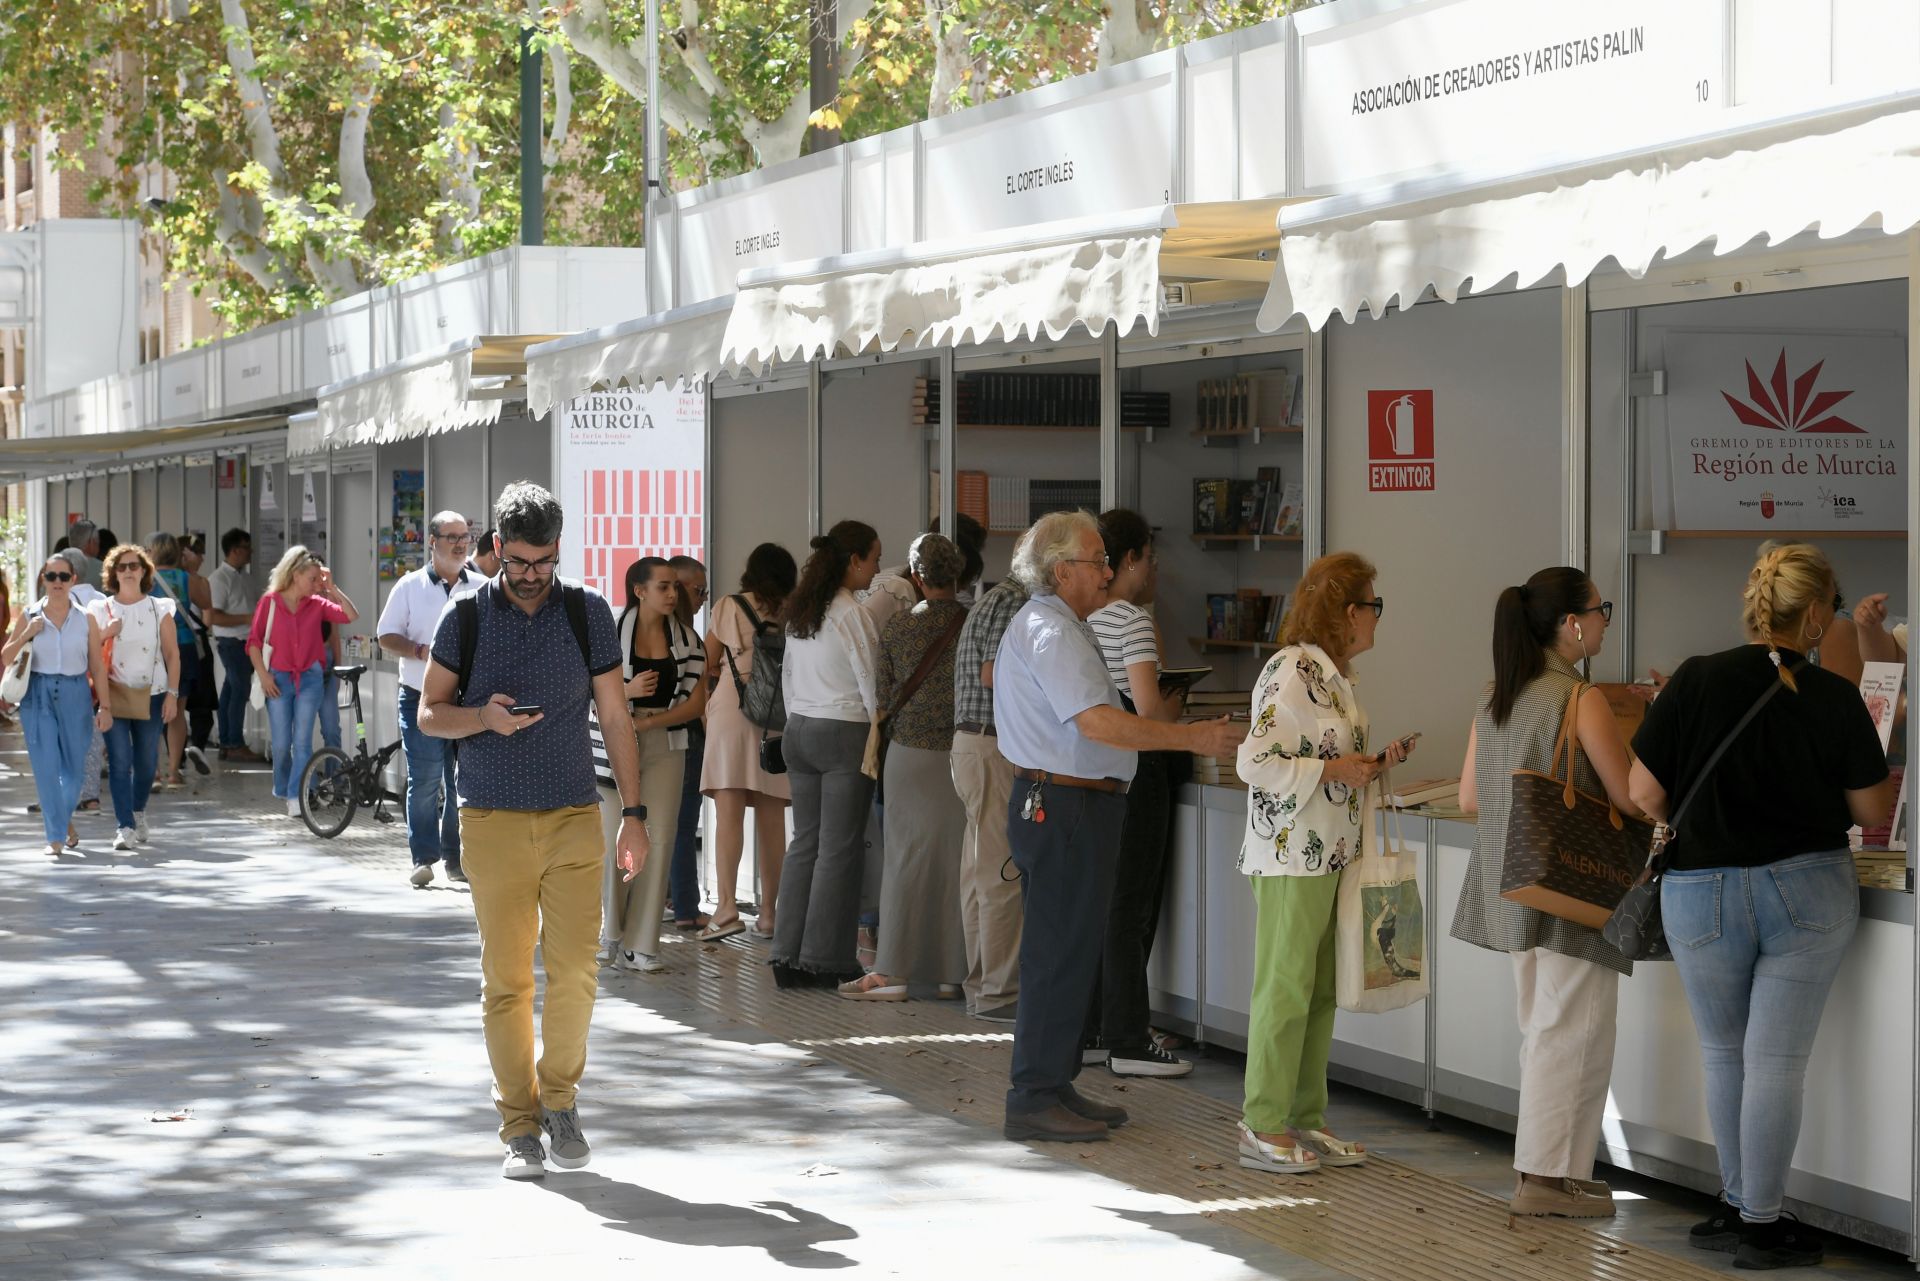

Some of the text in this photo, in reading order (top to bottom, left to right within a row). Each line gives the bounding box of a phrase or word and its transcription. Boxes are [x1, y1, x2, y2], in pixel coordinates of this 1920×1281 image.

[1352, 26, 1644, 116] ASOCIACIÓN DE CREADORES Y ARTISTAS PALIN
[1695, 79, 1709, 103] 10
[1006, 152, 1074, 195] EL CORTE INGLÉS
[735, 240, 742, 256] EL
[743, 235, 760, 254] CORTE
[570, 396, 634, 412] LIBRO
[570, 413, 655, 429] MURCIA
[1690, 438, 1896, 449] GREMIO DE EDITORES DE LA
[1371, 465, 1432, 488] EXTINTOR
[1692, 452, 1897, 482] Región de Murcia
[1739, 500, 1759, 508] Región
[1833, 494, 1856, 507] ica
